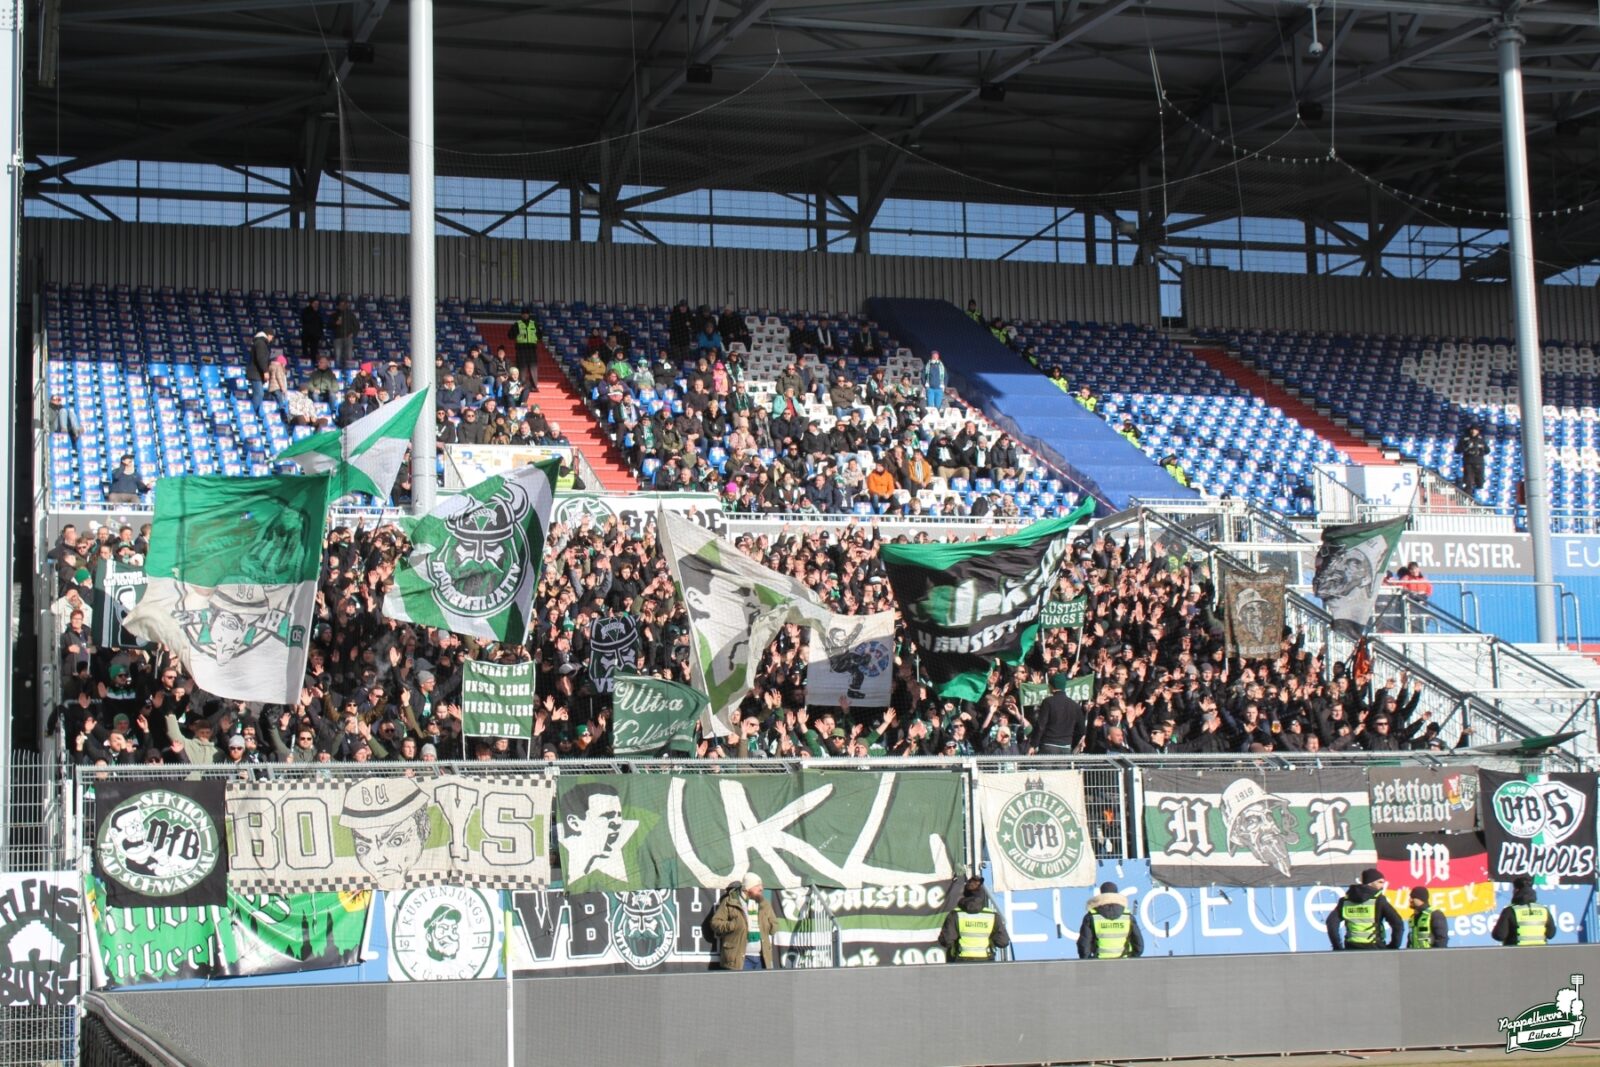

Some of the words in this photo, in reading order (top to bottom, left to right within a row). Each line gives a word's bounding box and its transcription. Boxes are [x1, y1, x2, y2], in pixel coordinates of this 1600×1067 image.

[1445, 543, 1520, 569] FASTER.
[512, 665, 529, 677] IST
[479, 722, 499, 734] DER
[1373, 778, 1444, 805] sektion
[140, 791, 212, 833] SEKTION
[1371, 801, 1452, 825] neustadt
[119, 849, 216, 895] SCHWARTAU
[1406, 842, 1449, 885] VfB
[1499, 843, 1528, 875] HL
[1529, 845, 1594, 876] HOOLS
[402, 886, 485, 926] KÜSTENJUNGS
